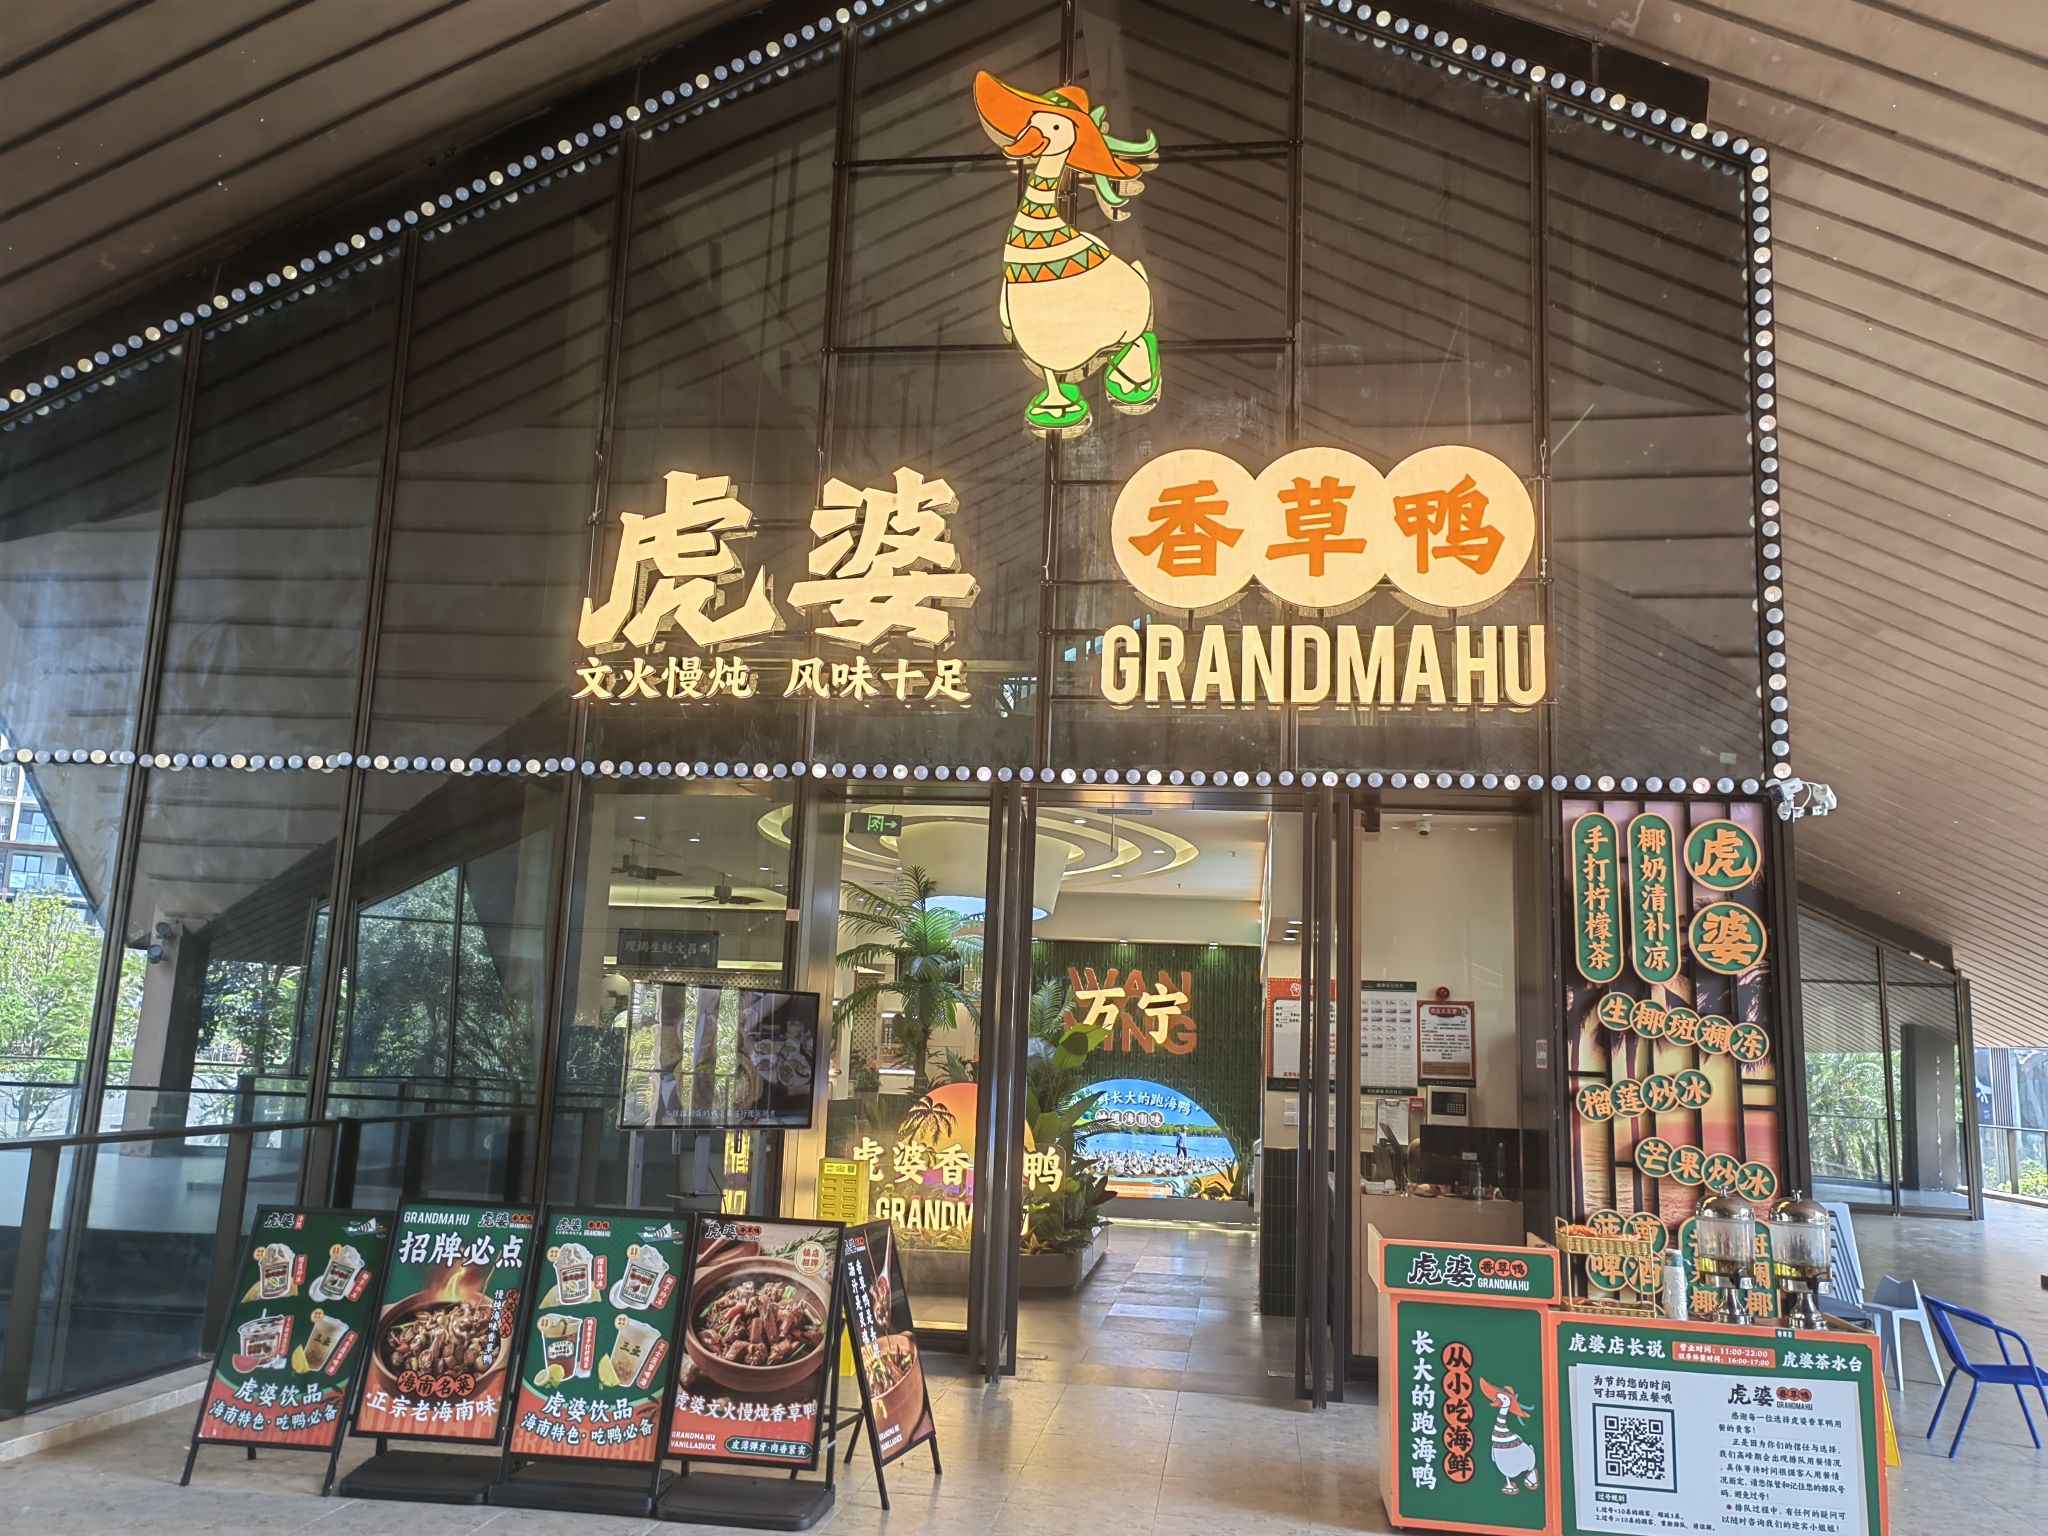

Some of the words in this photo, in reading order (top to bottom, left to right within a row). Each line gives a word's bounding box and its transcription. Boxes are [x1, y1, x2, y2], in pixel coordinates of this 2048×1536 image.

[1129, 473, 1505, 577] 香草鸭
[577, 466, 977, 648] 虎婆
[571, 656, 755, 701] 文火慢炖
[783, 657, 972, 702] 风味十足
[1101, 624, 1546, 706] GRANDMAHU
[1583, 825, 1614, 970] 手打柠檬茶
[1637, 825, 1670, 971] 椰奶清补凉
[1694, 828, 1759, 966] 虎婆
[1076, 982, 1188, 1044] 万宁
[1602, 997, 1764, 1059] 生椰斑斓冻
[1064, 1011, 1198, 1055] ING
[1582, 1075, 1712, 1116] 榴莲炒冰
[853, 1137, 1064, 1192] 虎婆香鸭
[1641, 1142, 1771, 1197] 芒果炒冰
[404, 1211, 470, 1226] GRANDMAHU
[478, 1211, 510, 1228] 虎婆
[399, 1231, 524, 1269] 招牌必点
[1407, 1251, 1476, 1288] 虎婆
[1480, 1260, 1525, 1276] 香草鸭
[1478, 1277, 1530, 1292] GRANDMAHU
[1591, 1256, 1662, 1286] 啤酒
[1569, 1333, 1665, 1358] 虎婆店长说
[1720, 1347, 1768, 1358] 11:00-22:00
[1728, 1357, 1770, 1366] 16:00-17:00
[1782, 1350, 1863, 1373] 虎婆茶水台
[234, 1377, 323, 1408] 虎婆饮品
[399, 1372, 473, 1396] 海南名菜
[1593, 1375, 1671, 1391] 为节约您的时间
[1594, 1388, 1673, 1404] 可扫码预点餐哦
[1728, 1383, 1775, 1407] 虎婆
[1778, 1388, 1811, 1401] 香草鸭
[541, 1391, 633, 1423] 虎婆饮品
[675, 1393, 818, 1422] 虎婆文火慢炖香草鸭
[1411, 1330, 1437, 1491] 长大的跑海鸭
[1446, 1346, 1473, 1480] 从小吃海鲜
[1731, 1411, 1842, 1428] 感谢每一位选择虎婆香草鸭用
[1776, 1401, 1813, 1411] GRANDMAHU
[671, 1441, 717, 1450] VANILLADUCK
[672, 1431, 704, 1440] GRANDMA
[1720, 1450, 1842, 1467] 我们高峰期会出现排队用餐情况
